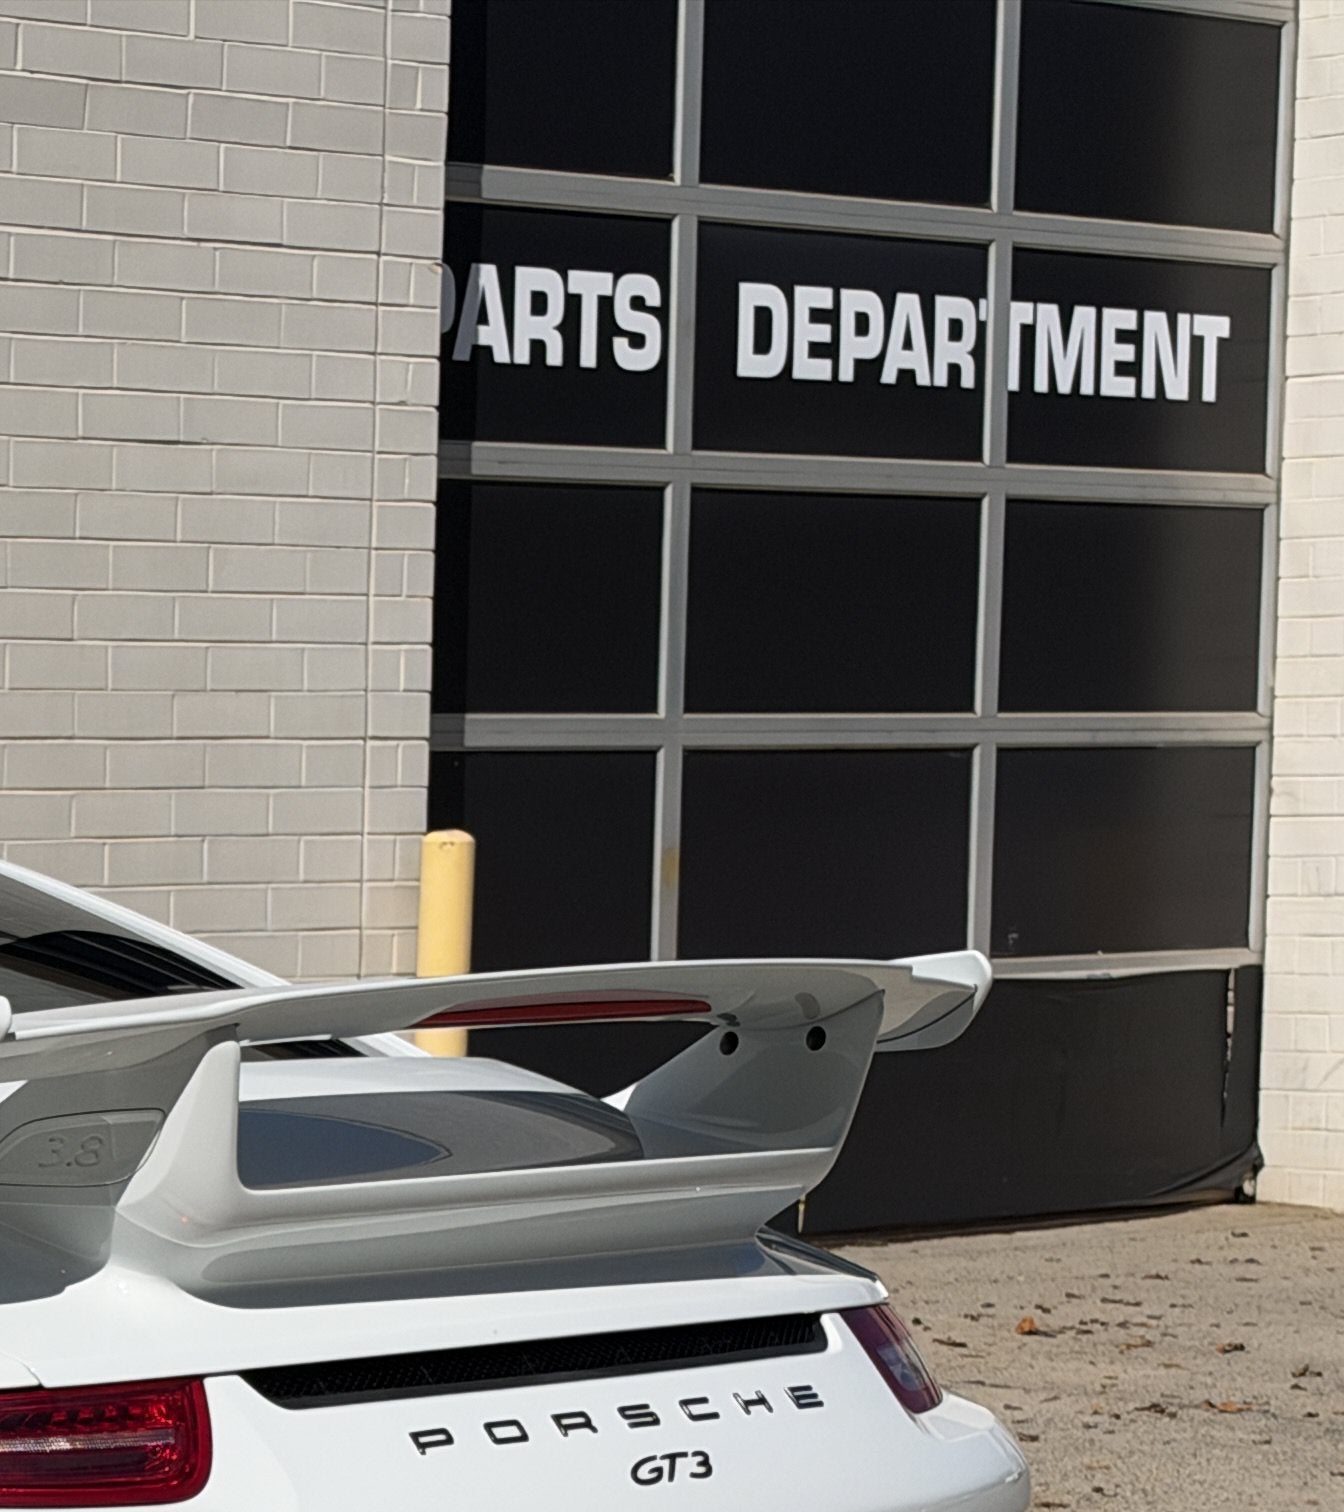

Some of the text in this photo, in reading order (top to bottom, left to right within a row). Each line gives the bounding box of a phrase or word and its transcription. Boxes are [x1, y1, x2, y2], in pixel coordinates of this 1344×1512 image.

[736, 281, 1231, 403] DEPARTMENT
[38, 1135, 105, 1168] 3.8
[408, 1384, 825, 1456] PORSCHE
[630, 1450, 714, 1486] GT3
